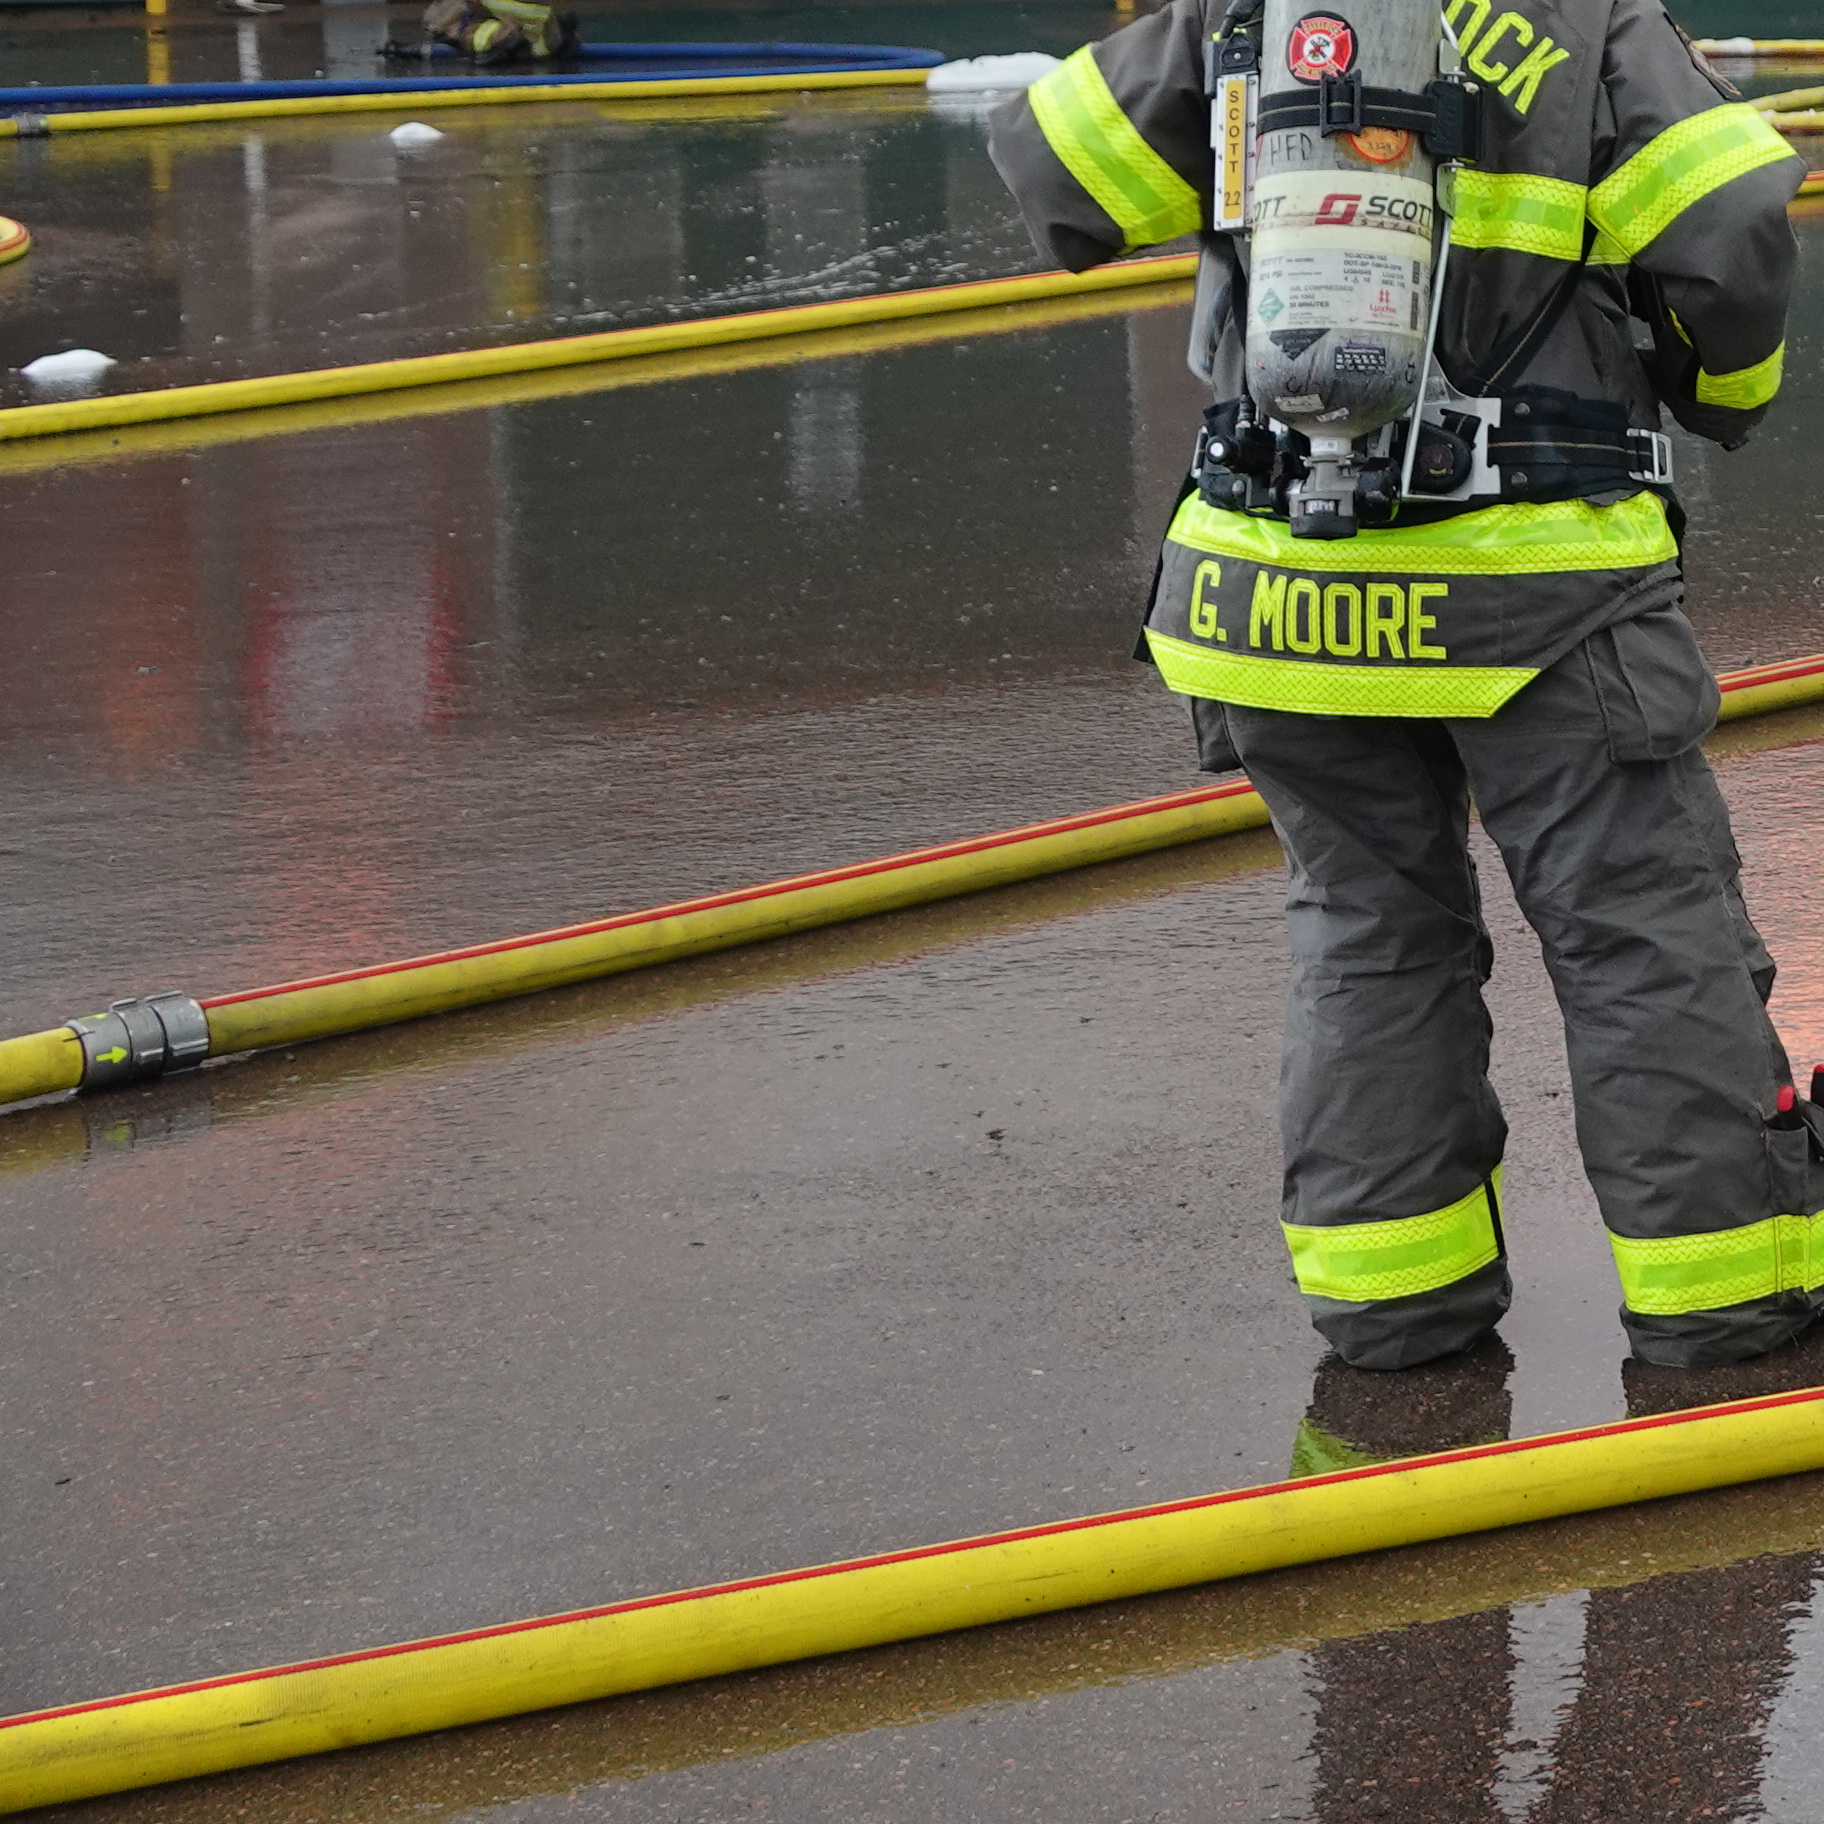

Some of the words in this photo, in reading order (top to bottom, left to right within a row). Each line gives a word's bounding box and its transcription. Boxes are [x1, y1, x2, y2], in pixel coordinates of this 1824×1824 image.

[1228, 90, 1240, 174] SCOTT
[1224, 192, 1241, 207] 22
[1190, 558, 1228, 642] G.
[1250, 570, 1449, 660] MOORE
